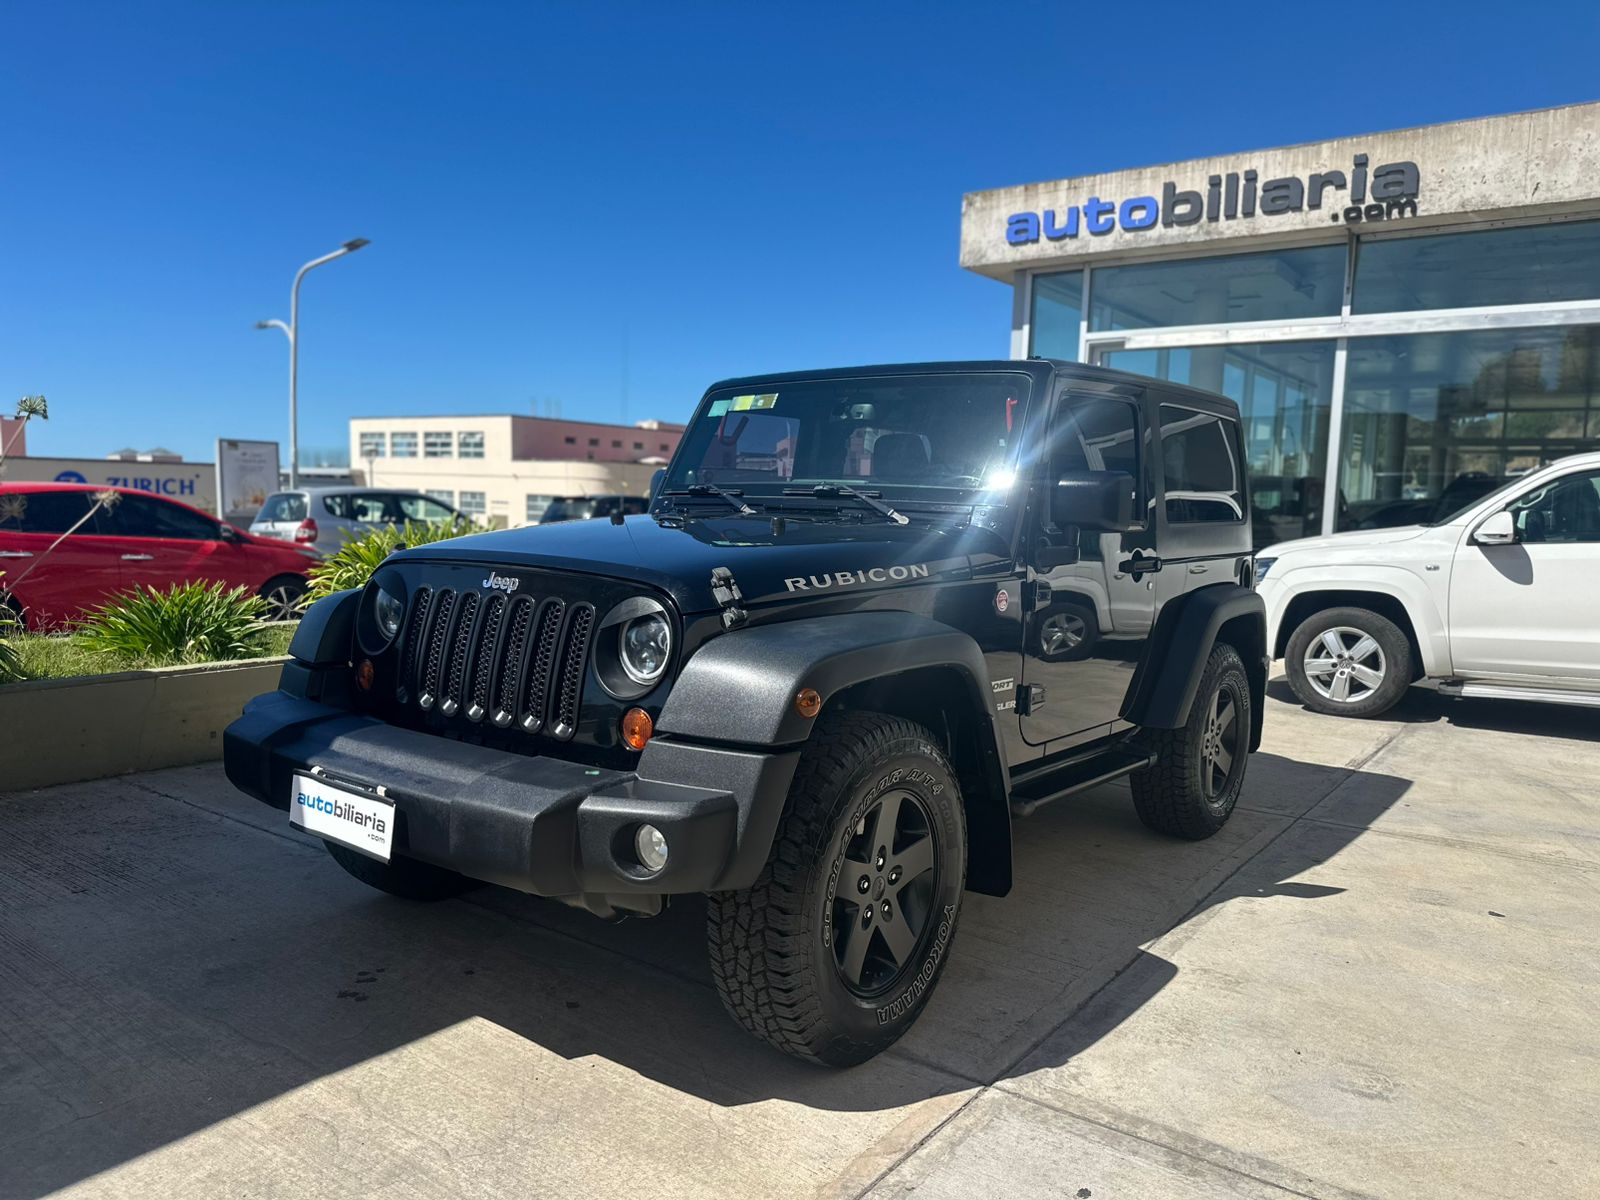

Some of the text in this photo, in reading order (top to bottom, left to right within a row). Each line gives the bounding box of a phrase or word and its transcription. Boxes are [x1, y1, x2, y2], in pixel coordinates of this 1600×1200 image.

[1006, 154, 1420, 246] autobiliaria
[1331, 198, 1418, 223] .com
[482, 571, 519, 594] Jeep
[784, 564, 929, 592] RUBICON
[297, 792, 386, 833] autobiliaria
[367, 833, 386, 845] .com
[877, 904, 955, 1025] YOKOHAMA
